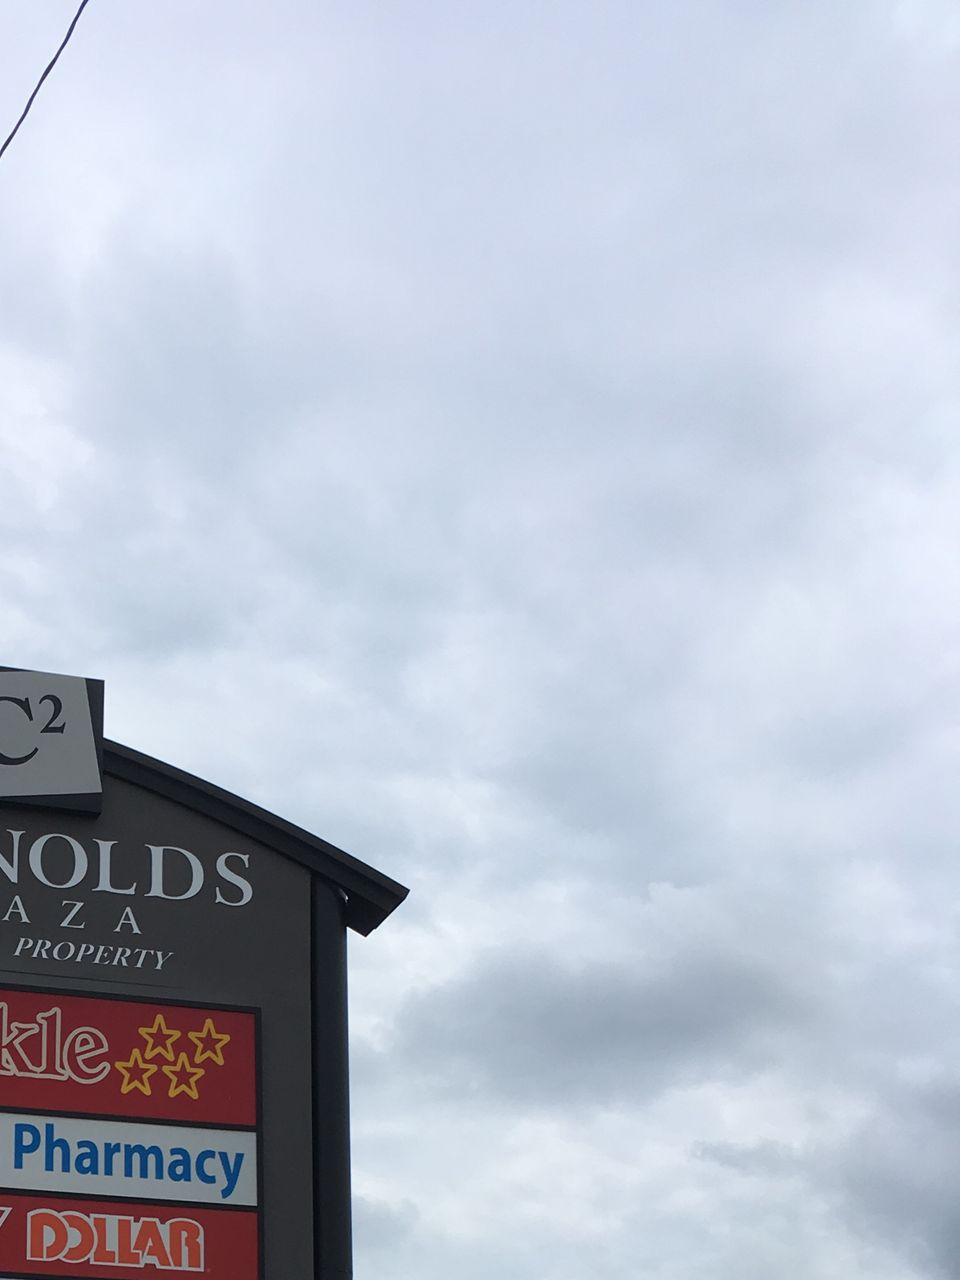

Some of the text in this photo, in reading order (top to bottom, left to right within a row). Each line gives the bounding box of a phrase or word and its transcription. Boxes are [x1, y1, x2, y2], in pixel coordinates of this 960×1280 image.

[12, 937, 174, 970] PROPERTY
[14, 1123, 244, 1199] Pharmacy
[26, 1208, 206, 1273] DOLLAR
